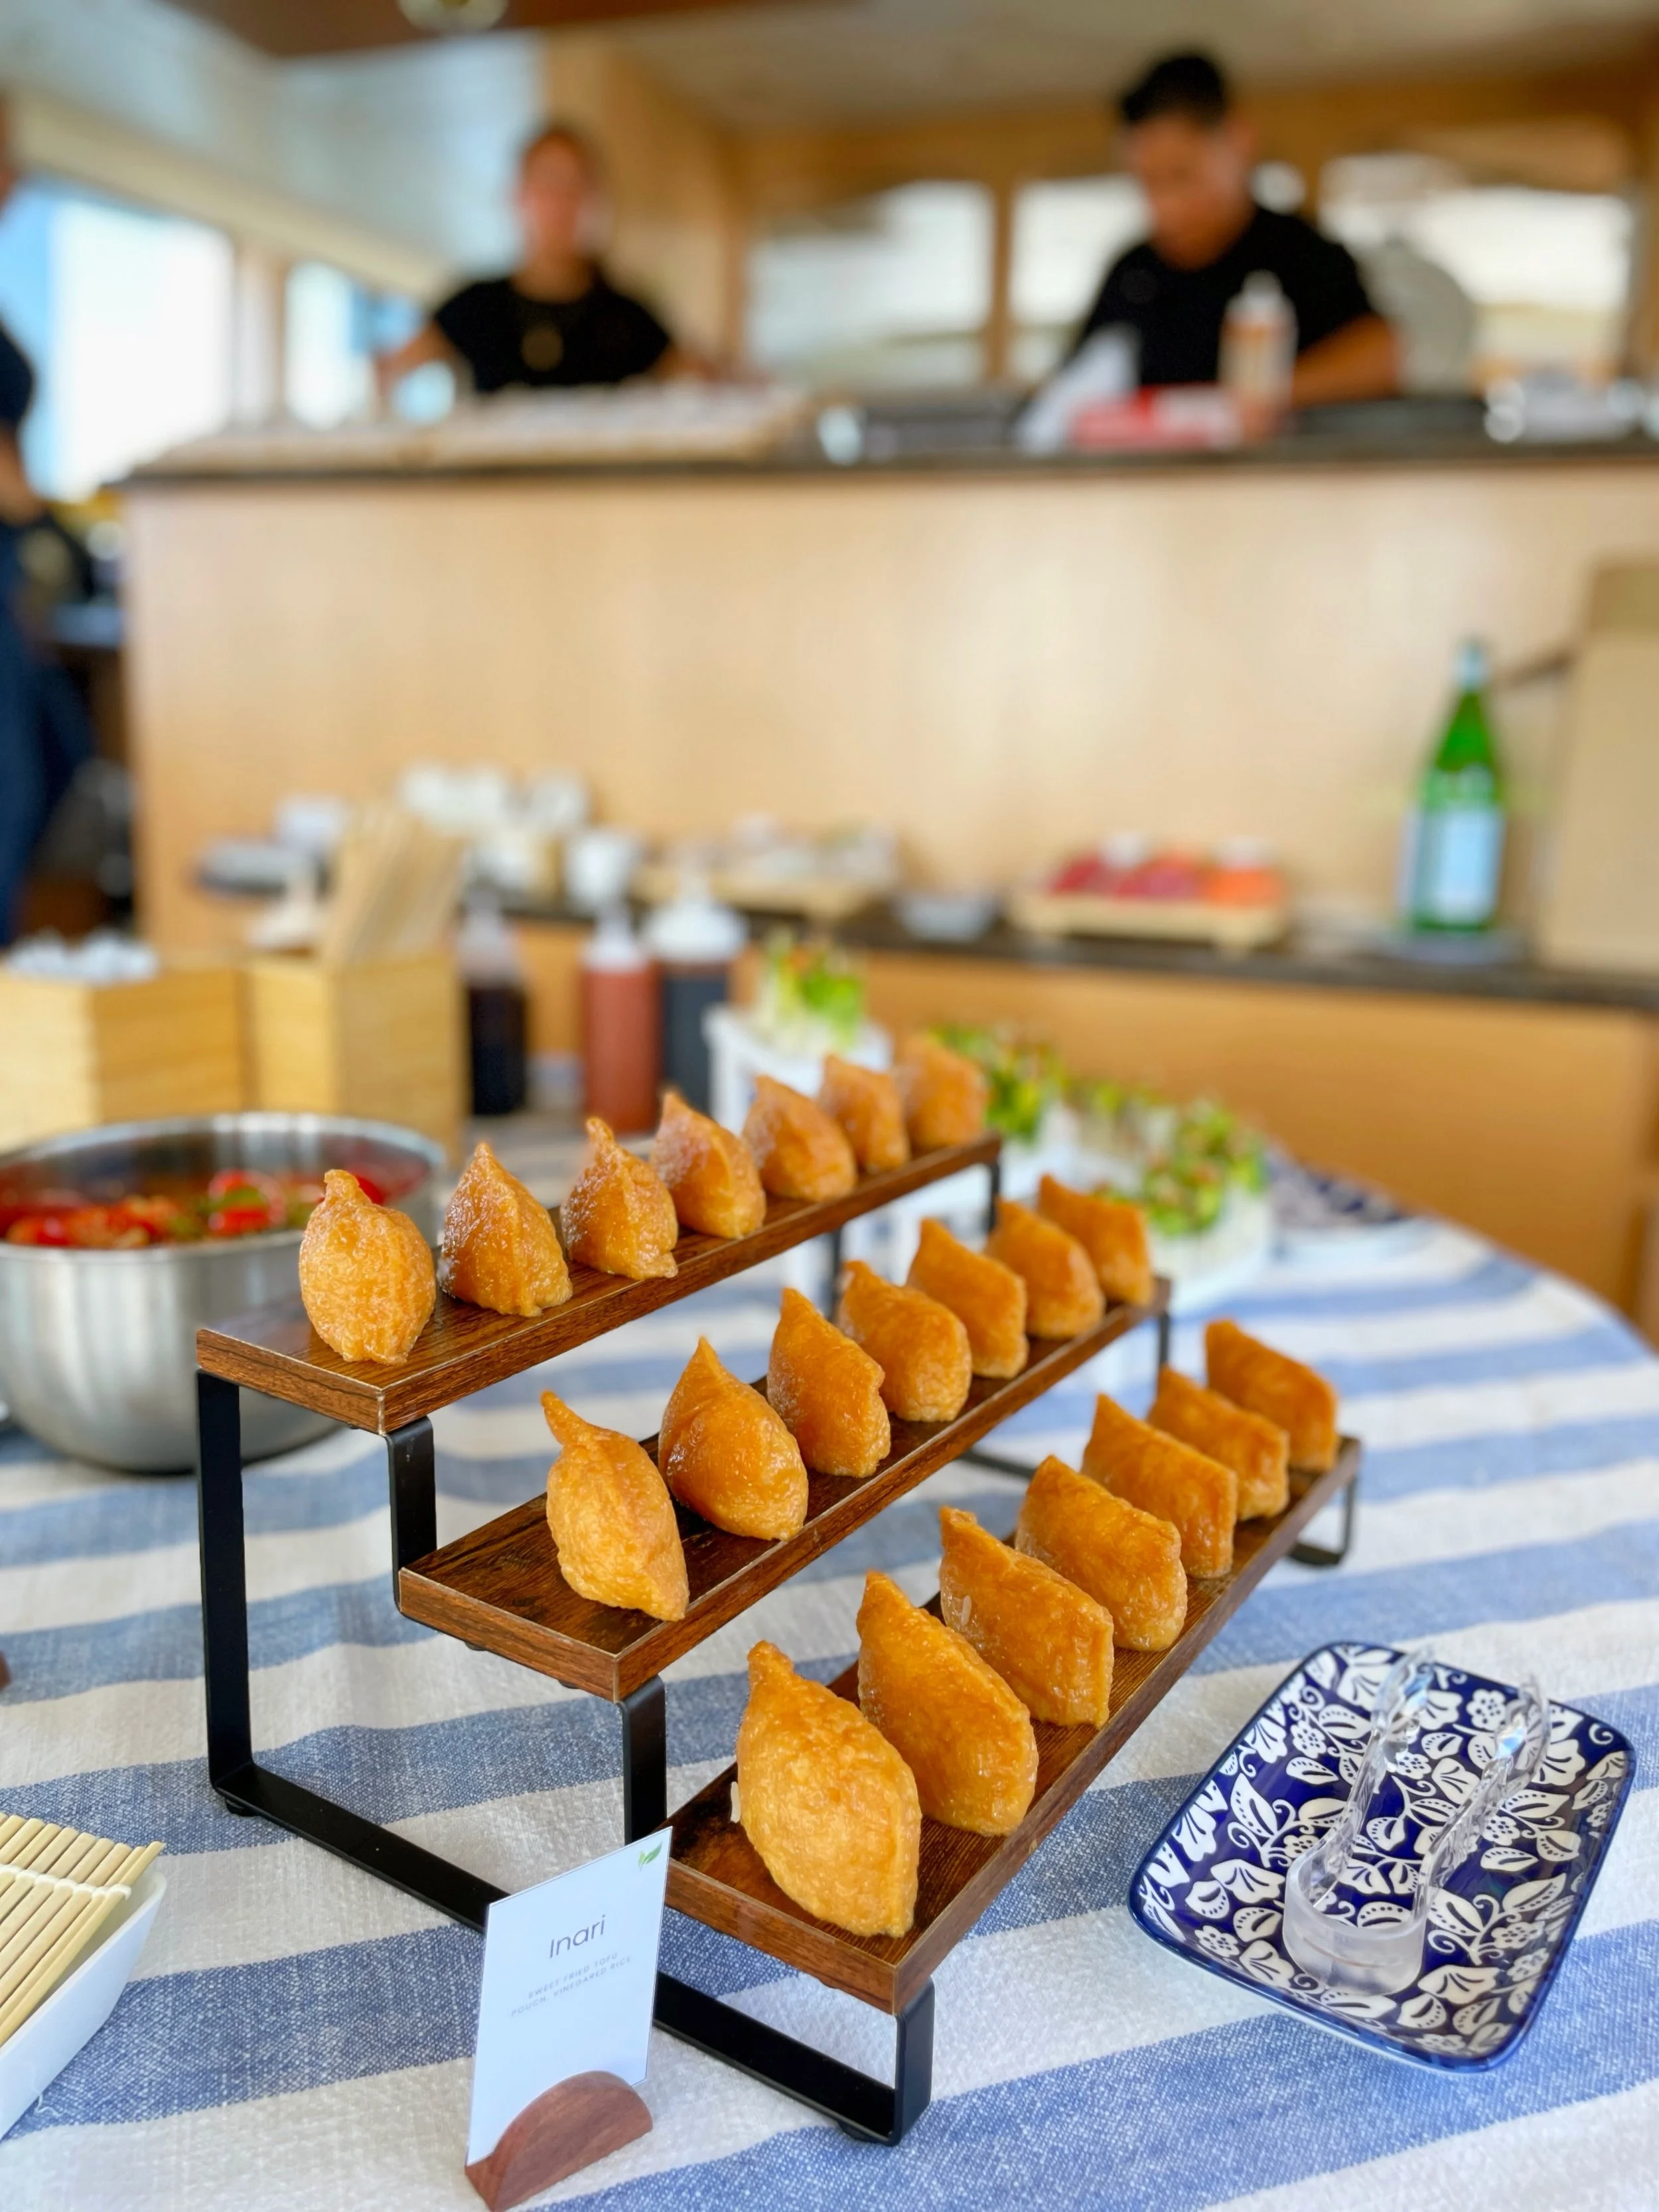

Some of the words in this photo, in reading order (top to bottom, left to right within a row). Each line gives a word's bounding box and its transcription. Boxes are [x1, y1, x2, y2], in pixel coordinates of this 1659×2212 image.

[549, 1914, 607, 1958] Inari
[528, 1978, 559, 1999] SWEET
[563, 1964, 590, 1982] FRIED
[595, 1952, 618, 1968] TOFU
[610, 1955, 632, 1970] RICE
